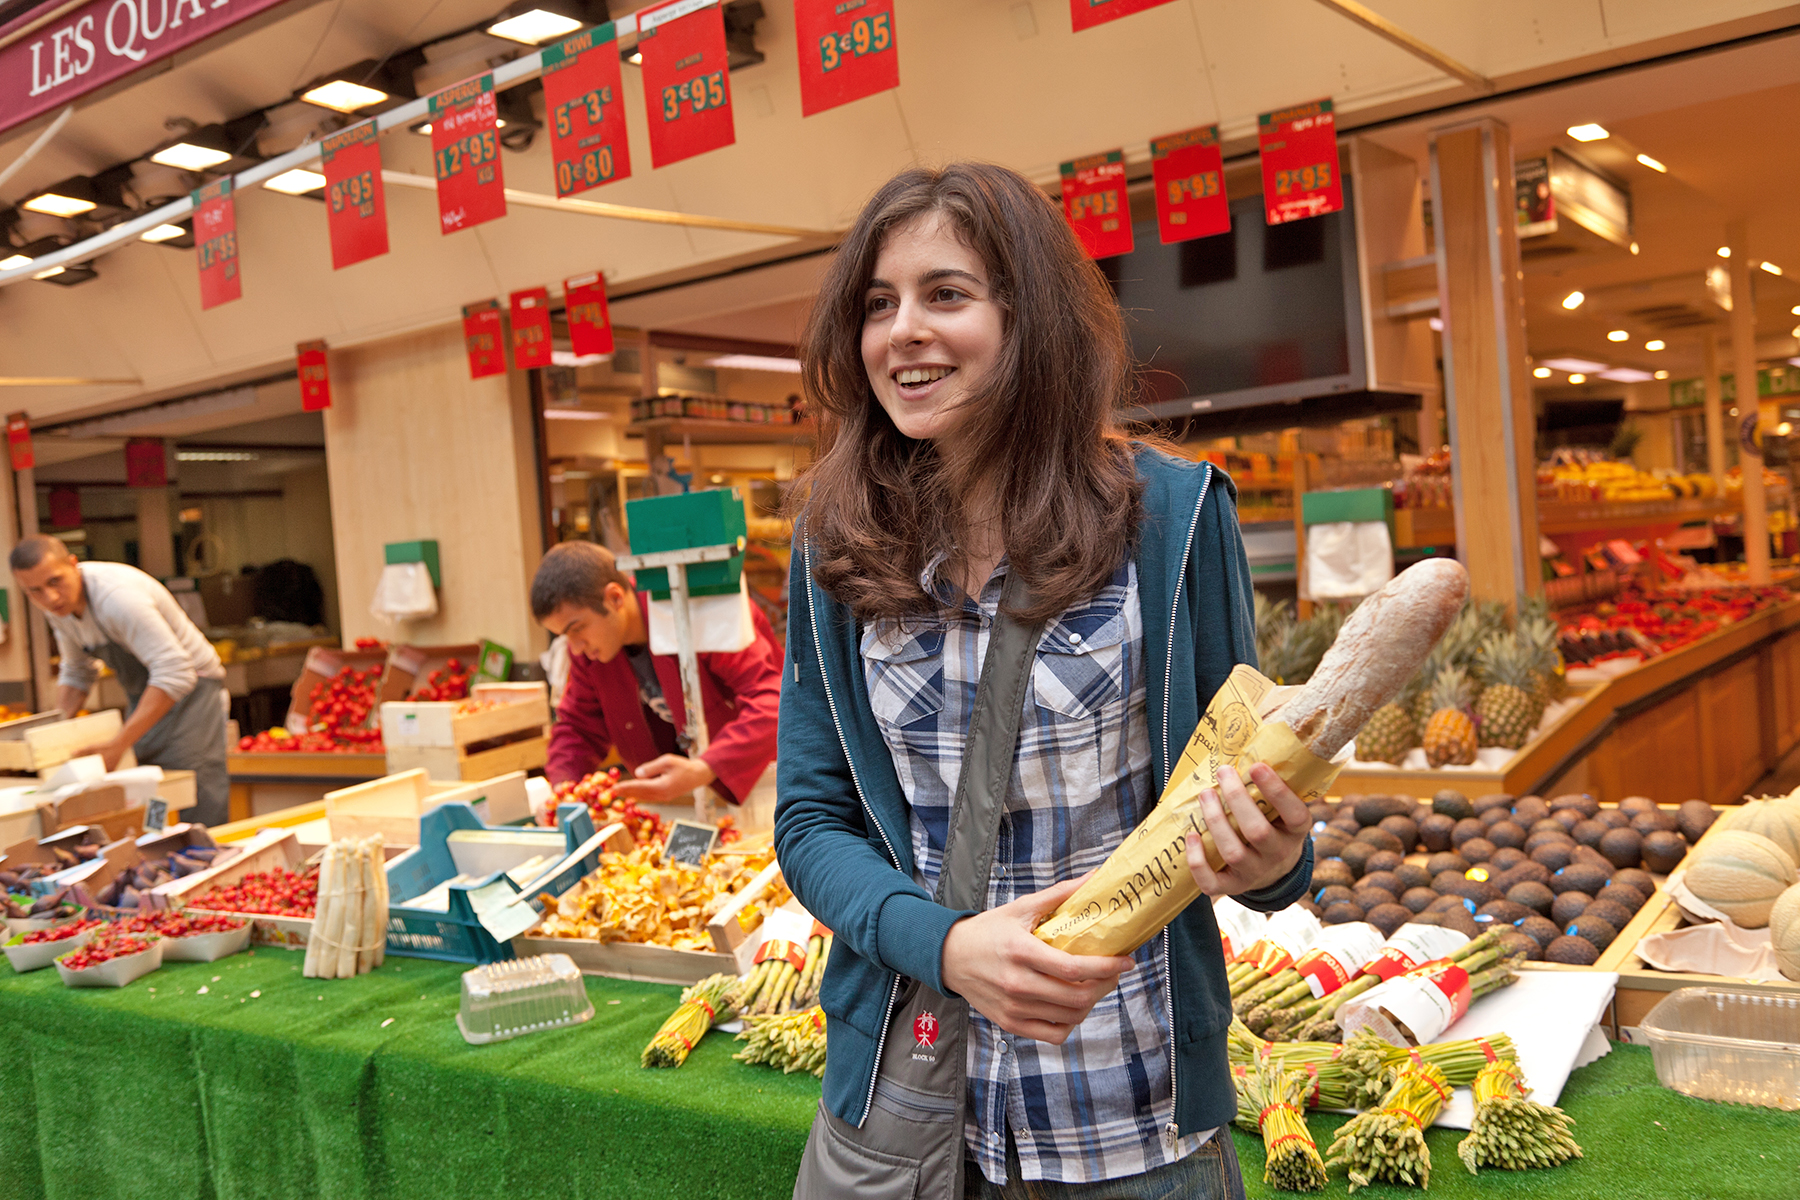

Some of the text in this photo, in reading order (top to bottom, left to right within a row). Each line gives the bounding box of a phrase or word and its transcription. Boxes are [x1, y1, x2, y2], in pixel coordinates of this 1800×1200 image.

[29, 15, 96, 97] LES
[563, 32, 593, 57] KIWI
[822, 14, 890, 69] 3€95
[664, 73, 724, 119] 3€95
[556, 106, 571, 136] 5
[436, 130, 497, 179] 12€95
[557, 147, 613, 192] 0€80
[330, 171, 373, 212] 9€95
[1277, 163, 1331, 194] 2€95
